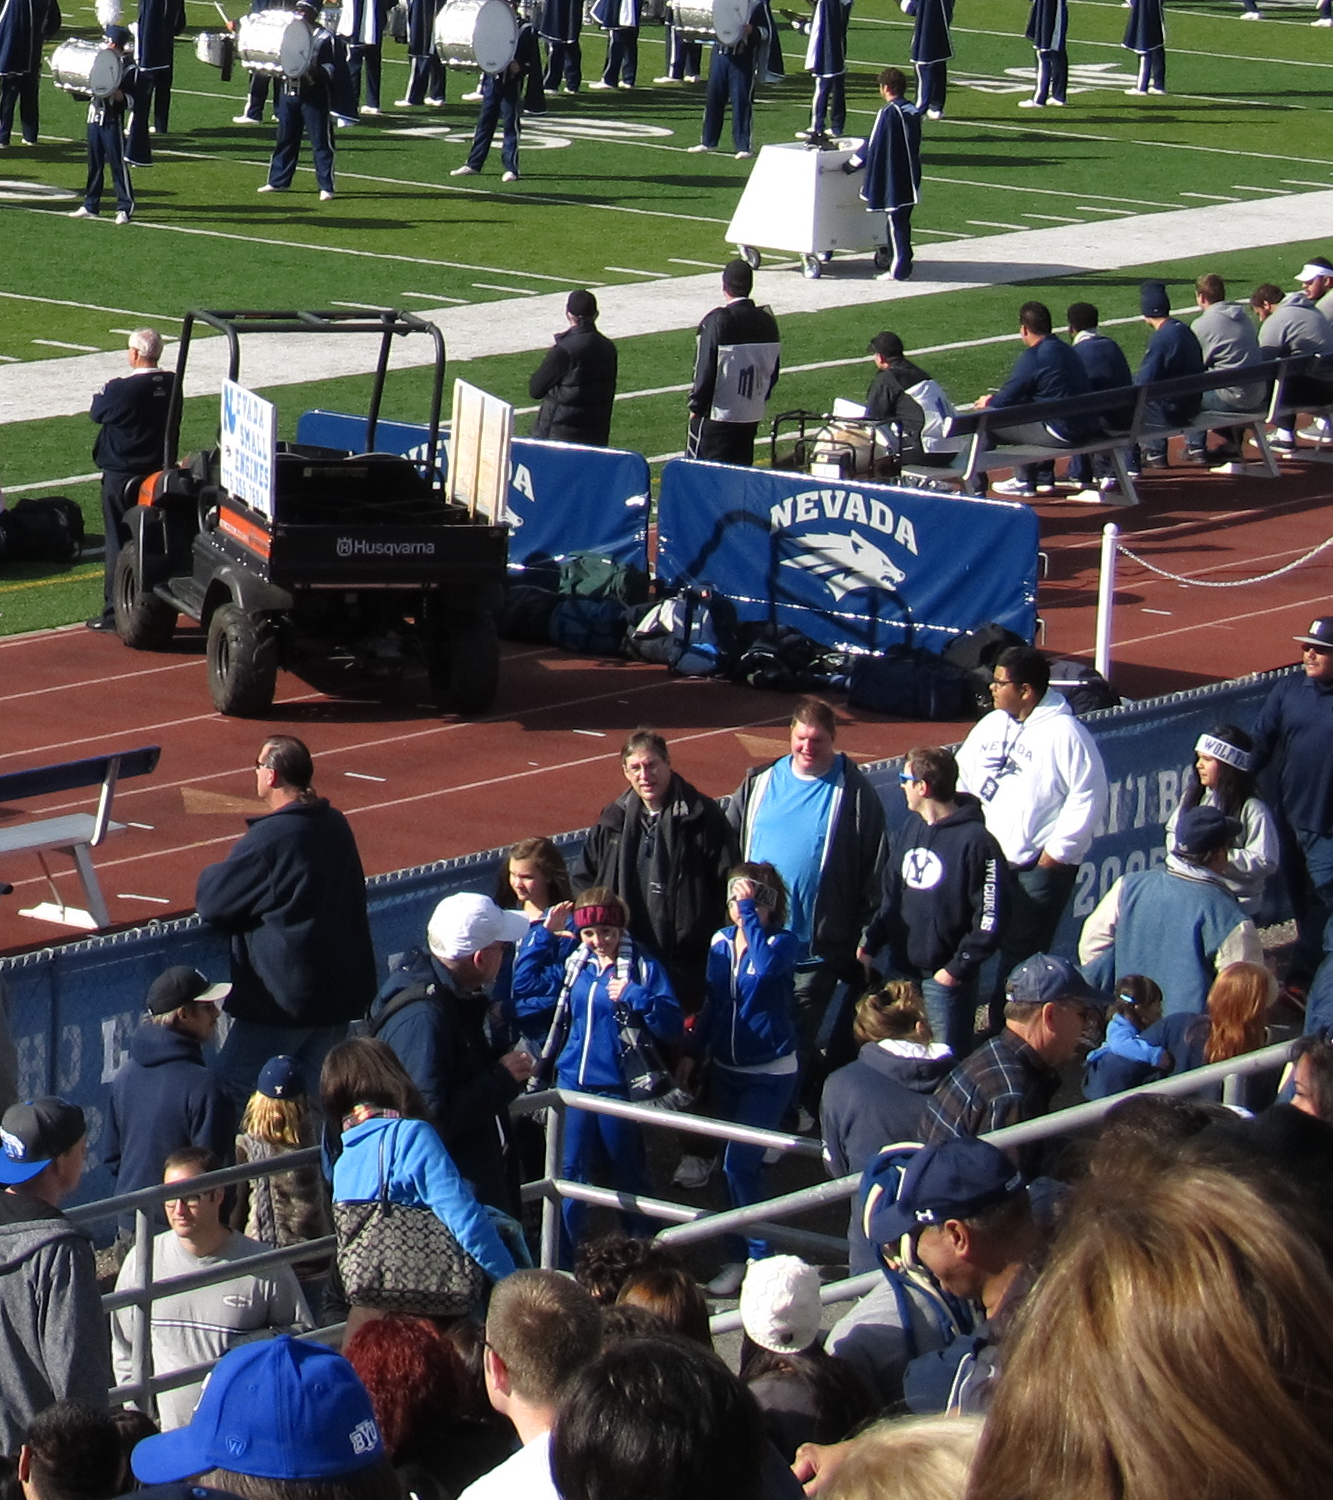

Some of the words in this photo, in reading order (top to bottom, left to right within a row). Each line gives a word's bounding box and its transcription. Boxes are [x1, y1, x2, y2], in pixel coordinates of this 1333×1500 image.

[239, 422, 268, 462] SMALL
[234, 447, 269, 492] ENGINES
[770, 488, 919, 557] NEVADA
[354, 538, 436, 557] Husqvarna
[909, 852, 934, 885] Y
[349, 1418, 380, 1455] BYU
